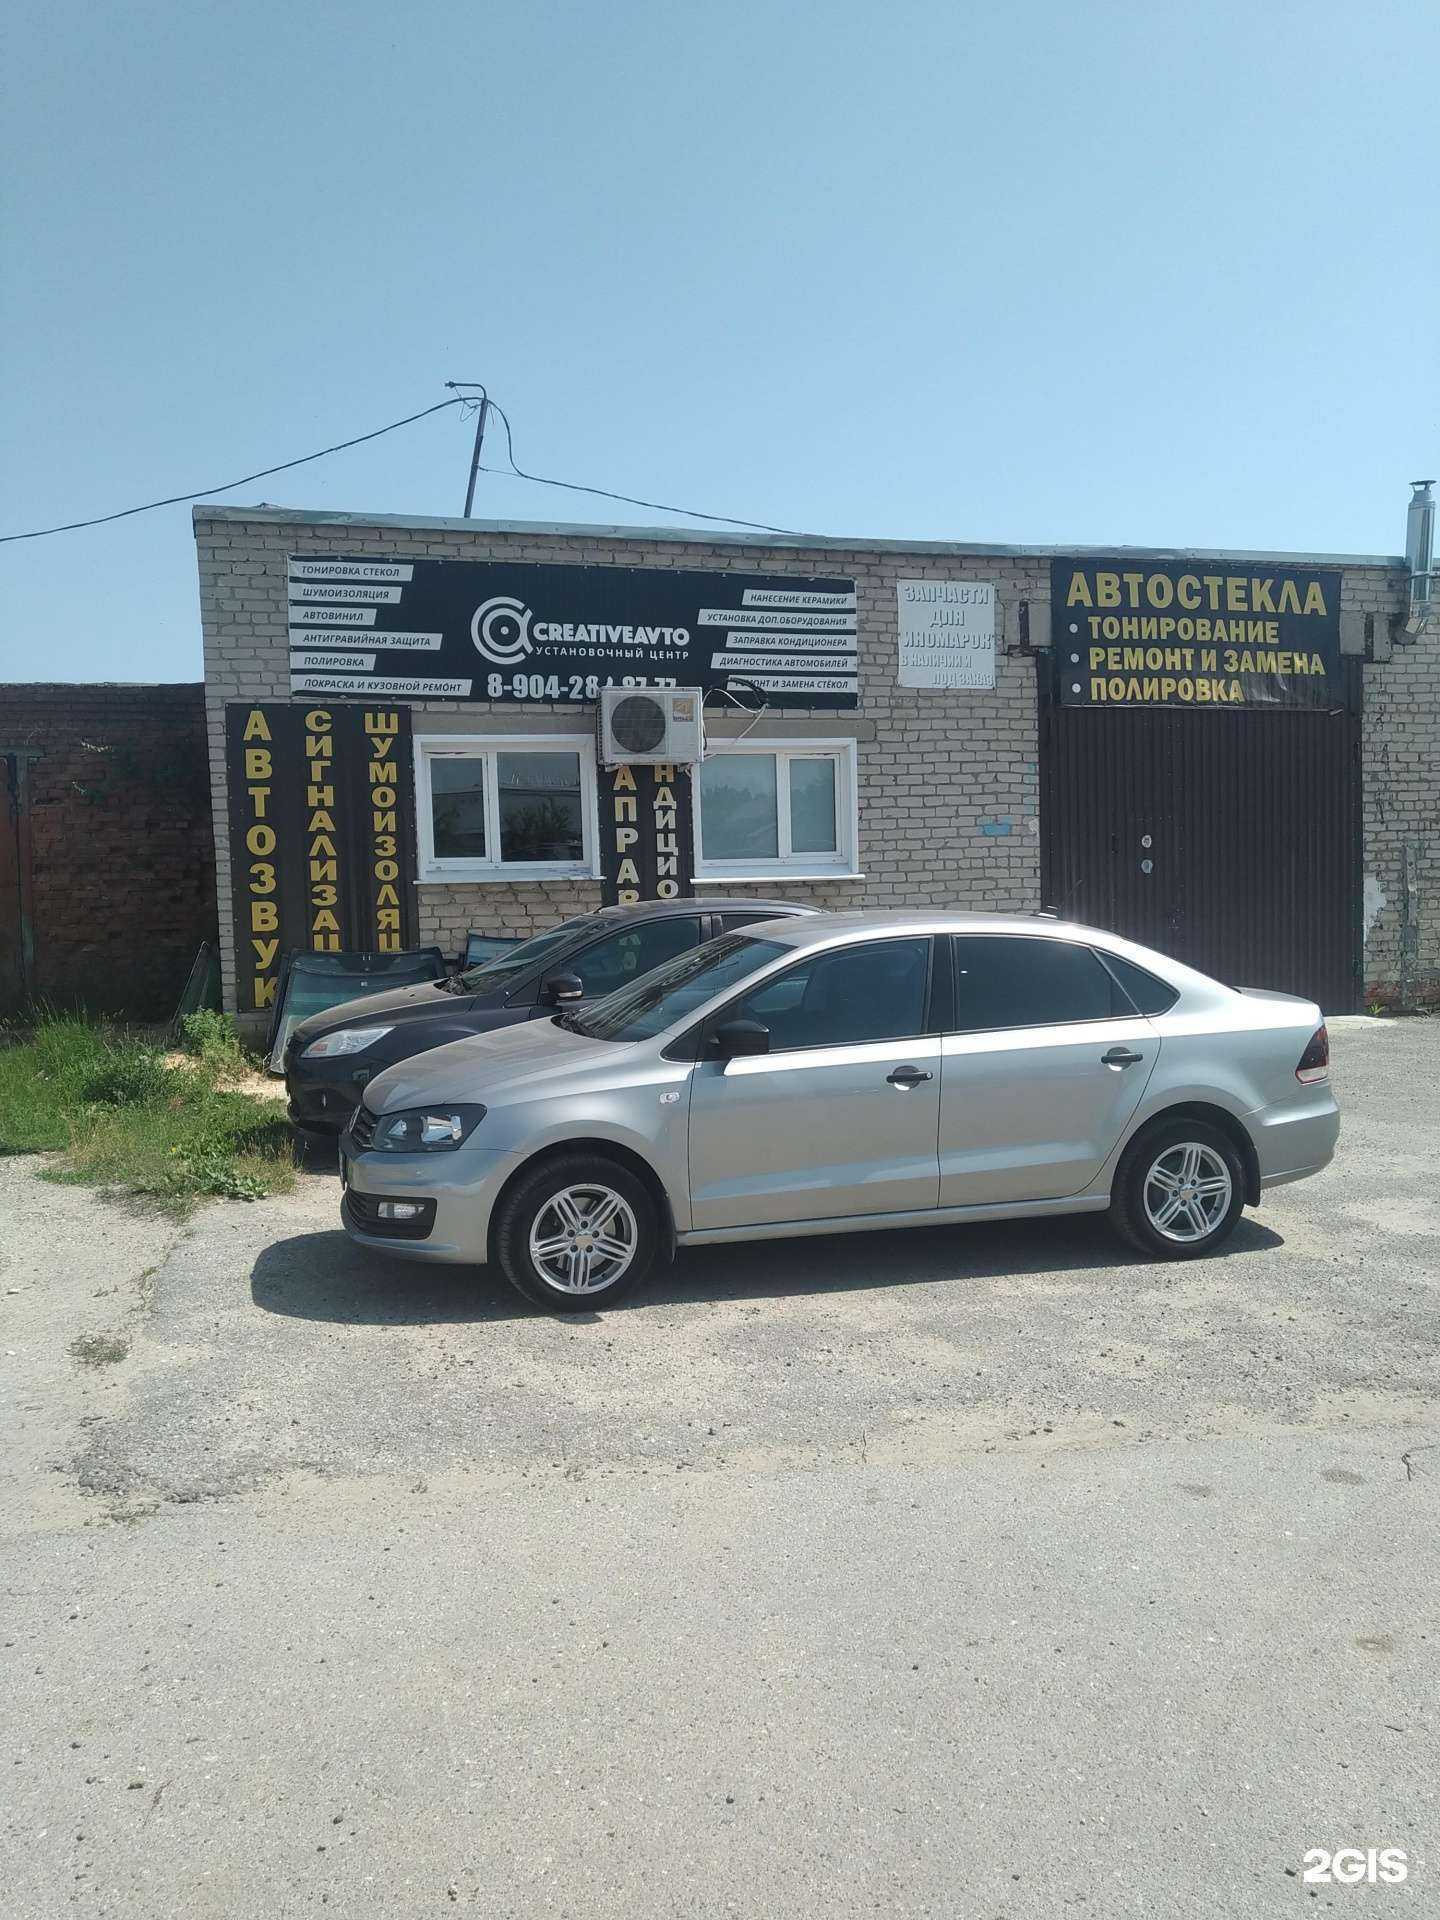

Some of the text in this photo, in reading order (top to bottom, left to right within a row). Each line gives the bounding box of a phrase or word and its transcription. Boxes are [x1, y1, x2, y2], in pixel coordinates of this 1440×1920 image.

[302, 565, 400, 577] ТОНИРОВКА СТЕКОЛ
[302, 588, 390, 600] ШУМОИЗОЛЯЦИЯ
[750, 594, 847, 605] НАНЕСЕНИЕ КЕРАМИКИ
[904, 585, 989, 605] ЗАПЧАСТИ
[1066, 572, 1328, 616] АВТОСТЕКЛА
[302, 611, 364, 622] АВТОВИНИЛ
[707, 613, 757, 624] УСТАНОВКА
[929, 609, 966, 628] ДЛЯ
[533, 622, 690, 646] CREATIVEAVTO
[1088, 616, 1280, 644] ТОНИРОВАНИЕ
[303, 633, 431, 647] АНТИГРАВИЙНАЯ ЗАЩИТА
[732, 636, 847, 647] ЗАПРАВКА КОНДИЦИОНЕРА
[903, 631, 993, 650] ИНОМАРОК
[536, 646, 689, 660] УСТАНОВОЧНЫЙ ЦЕНТР
[304, 656, 365, 667] ПОЛИРОВКА
[719, 657, 848, 668] ДИАГНОСТИКА АВТОМОБИЛЕЙ
[1089, 647, 1326, 675] РЕМОНТ И ЗАМЕНА
[304, 679, 463, 692] ПОКРАСКА И КУЗОВНОЙ РЕМОНТ
[736, 679, 848, 689] ОНТ И ЗАМЕНА СТЕКОЛ
[1090, 677, 1245, 702] ПОЛИРОВКА
[243, 710, 280, 1008] АВТОЗВУК
